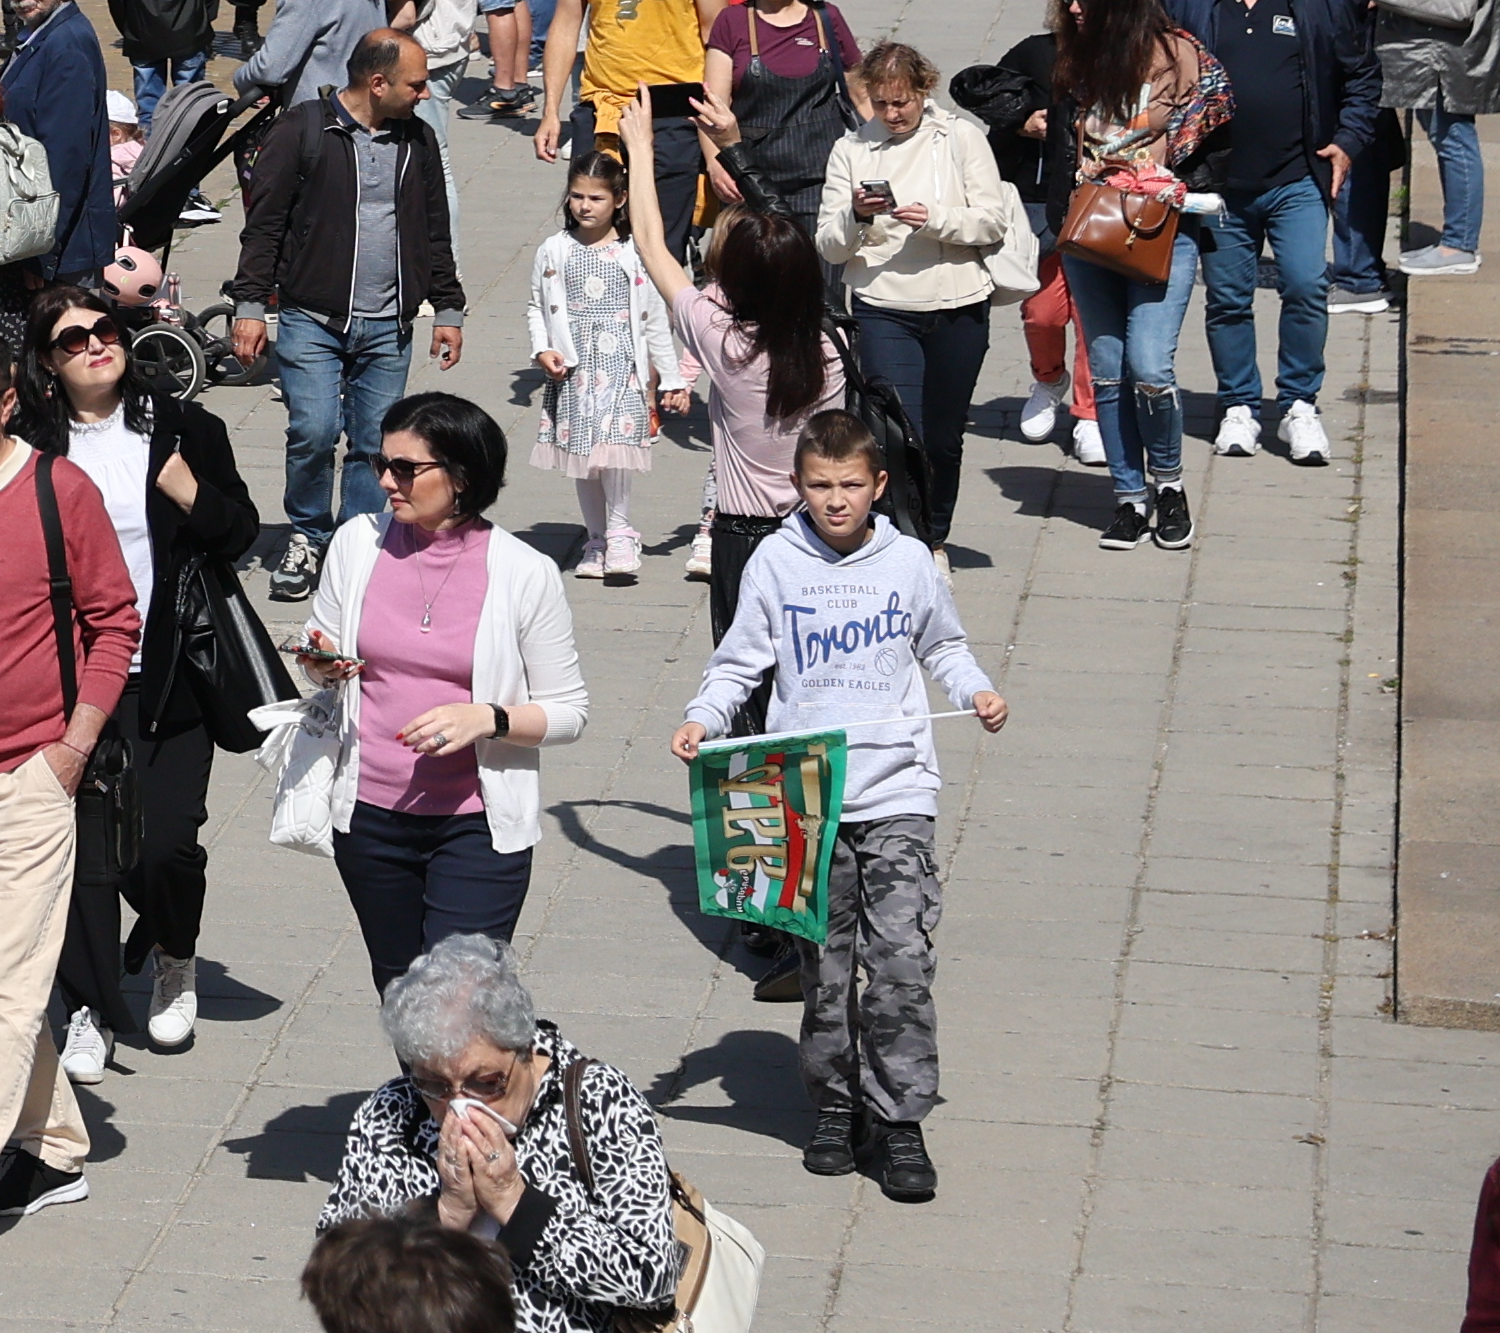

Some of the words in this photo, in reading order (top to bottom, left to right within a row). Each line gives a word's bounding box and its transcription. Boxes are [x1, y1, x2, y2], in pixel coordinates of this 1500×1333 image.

[801, 584, 880, 596] BASKETBALL
[827, 599, 858, 609] CLUB
[783, 590, 912, 675] Toronto
[801, 678, 844, 688] GOLDEN
[848, 679, 891, 691] EAGLES
